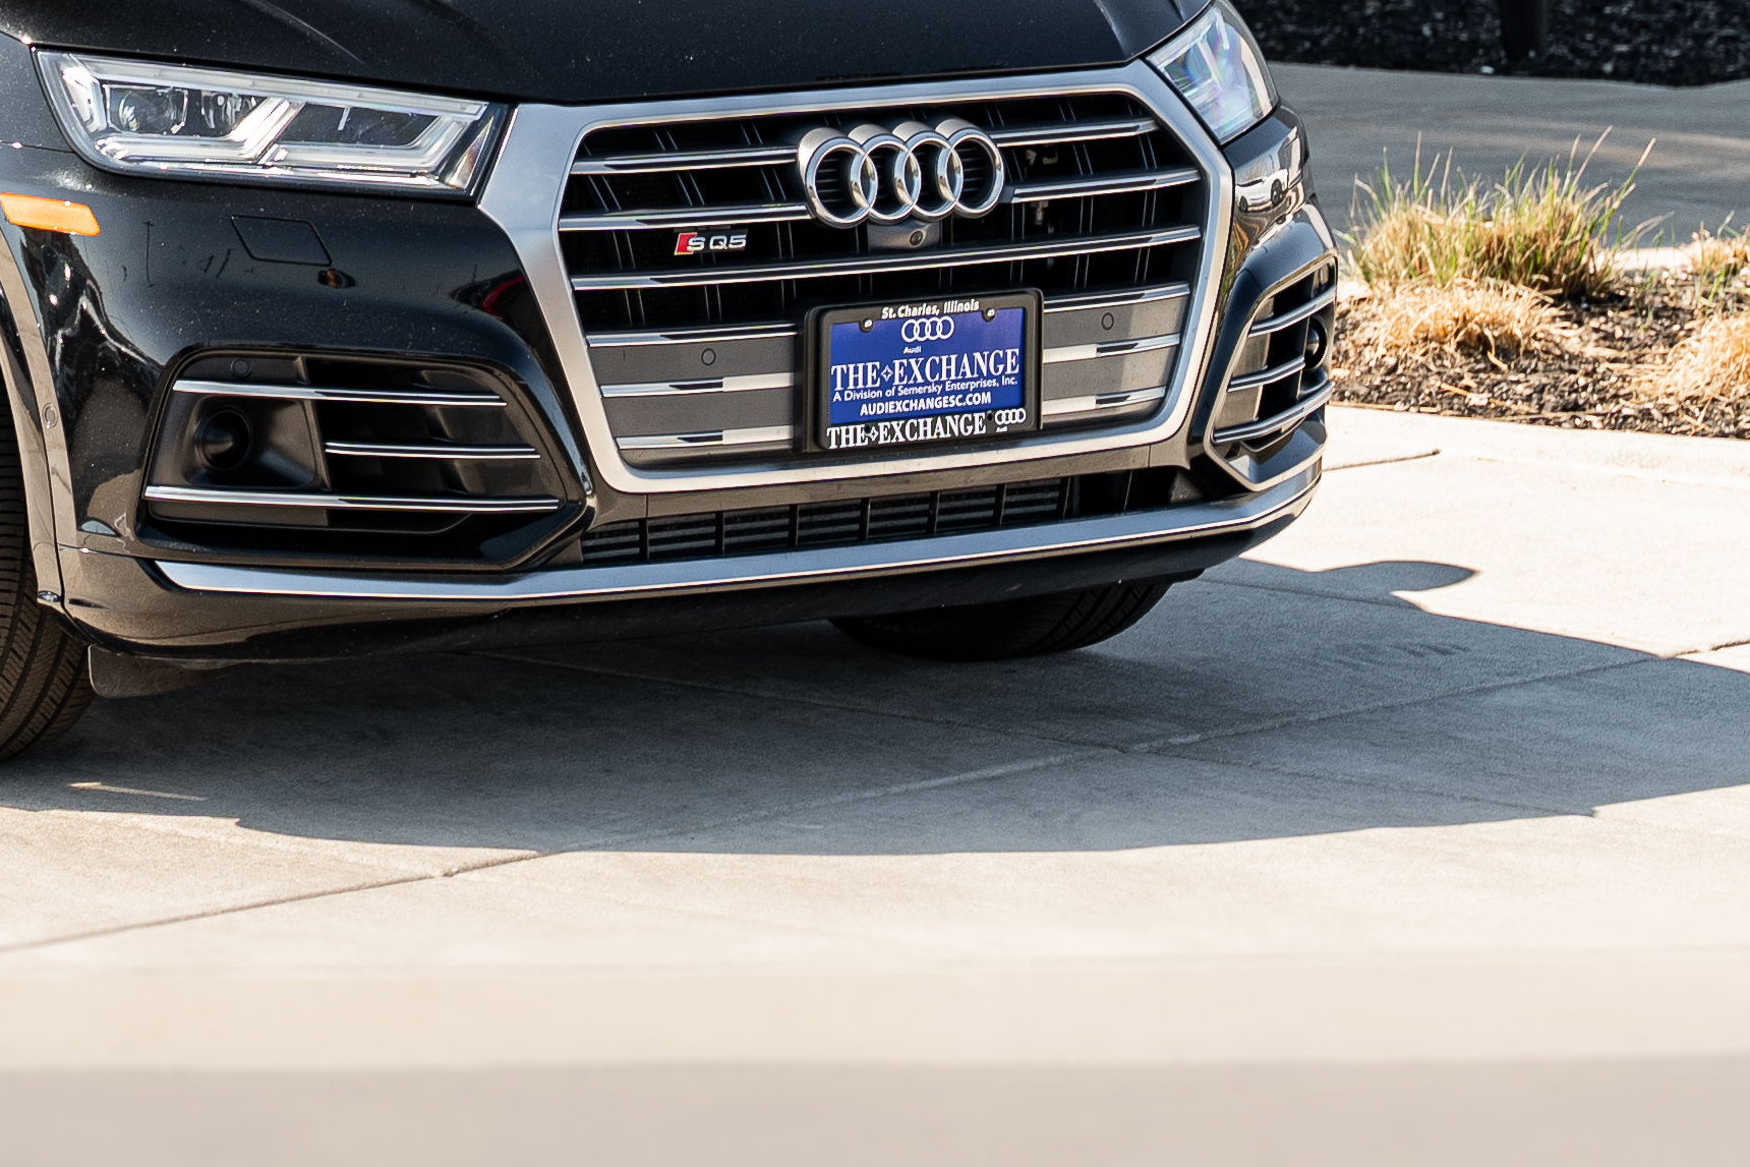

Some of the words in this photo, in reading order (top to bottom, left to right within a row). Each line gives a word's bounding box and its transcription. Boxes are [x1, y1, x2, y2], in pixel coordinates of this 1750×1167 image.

[685, 235, 747, 252] SQ5
[881, 307, 897, 319] St.
[897, 303, 940, 318] Charles,
[943, 298, 980, 314] Illinois
[831, 361, 881, 391] THE
[892, 348, 1020, 386] EXCHANGE
[832, 392, 842, 403] A
[844, 390, 883, 402] Division
[884, 386, 896, 398] of
[897, 380, 943, 397] Semersky
[945, 377, 1000, 392] Enterprises,
[1001, 375, 1018, 387] Inc.
[860, 391, 992, 416] AUDIEXCHANGESC.COM
[826, 424, 869, 449] THE
[877, 411, 987, 445] EXCHANGE
